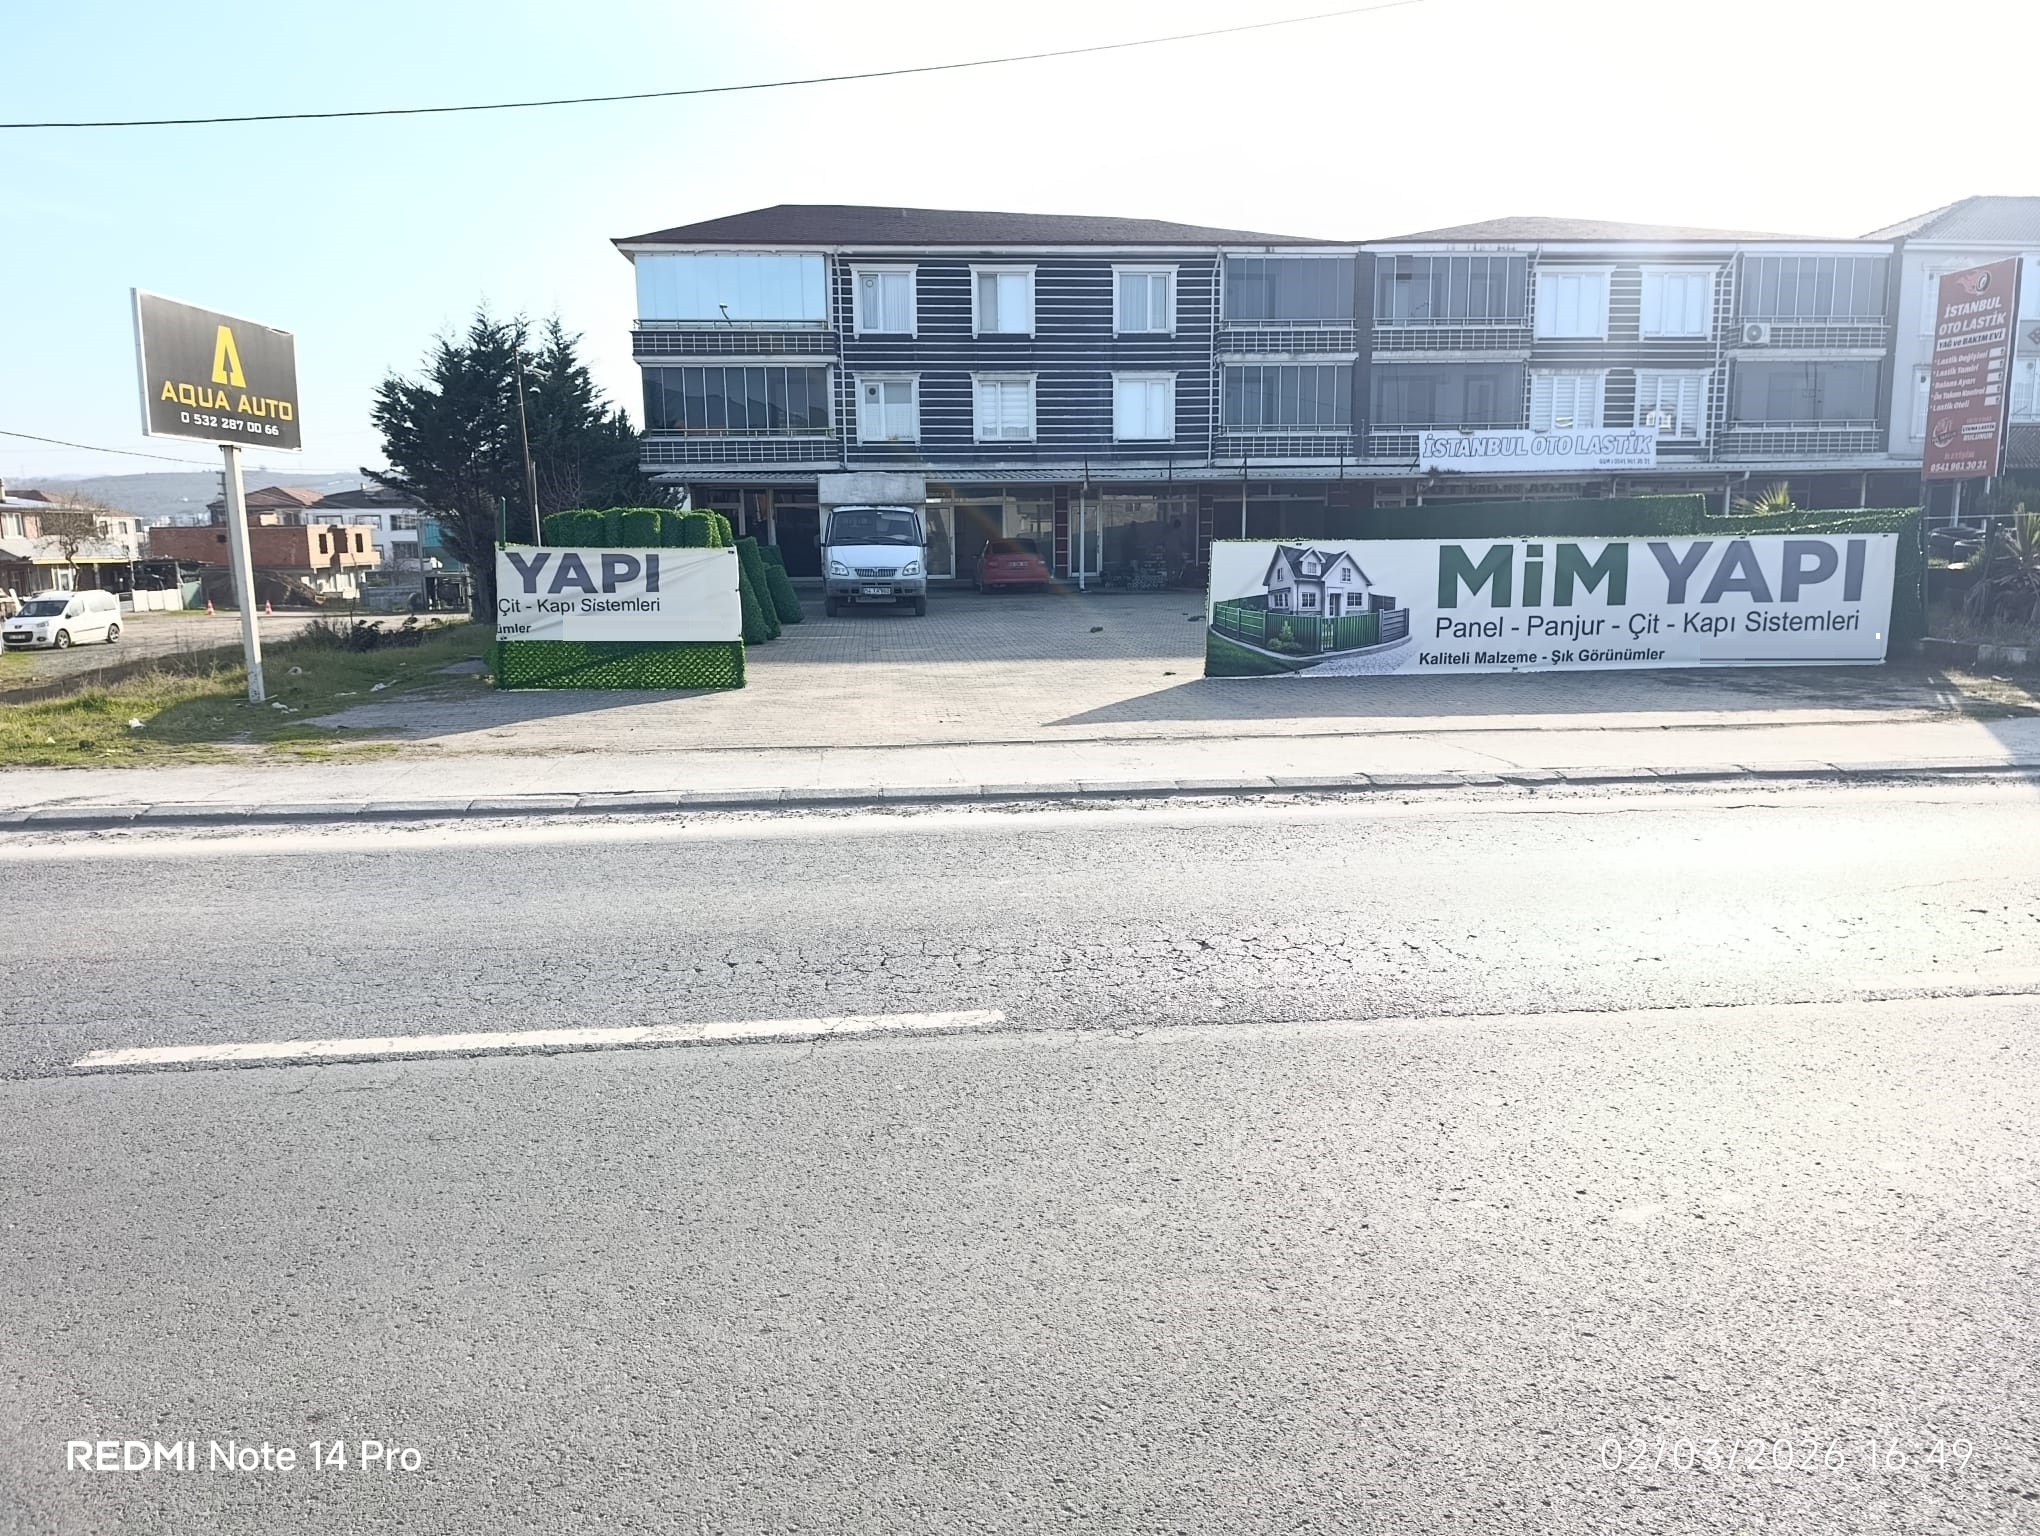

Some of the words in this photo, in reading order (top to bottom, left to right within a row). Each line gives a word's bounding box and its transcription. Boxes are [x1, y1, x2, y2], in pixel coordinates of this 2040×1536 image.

[1944, 296, 2002, 318] İSTANBUL
[1939, 321, 1960, 336] OTO
[1962, 311, 2007, 332] LASTİK
[161, 381, 230, 410] AQUA
[238, 394, 294, 421] AUTO
[180, 412, 189, 423] 0
[193, 414, 217, 427] 532
[221, 417, 243, 431] 287
[247, 421, 262, 433] 00
[265, 424, 279, 436] 66
[1423, 434, 1528, 458] İSTANBUL
[1531, 435, 1573, 456] OTO
[1575, 430, 1654, 455] LASTİK
[506, 552, 660, 594] YAPI
[1647, 539, 1866, 604] YAPI
[498, 597, 521, 616] Çit
[538, 599, 574, 616] Kapı
[581, 597, 660, 612] Sistemleri
[1435, 616, 1504, 638] Panel
[1528, 614, 1605, 641] Panjur
[1629, 612, 1659, 640] Çit
[1684, 612, 1735, 637] Kapı
[1745, 610, 1859, 633] Sistemleri
[1419, 651, 1470, 665] Kaliteli
[1474, 651, 1537, 665] Malzeme
[1551, 649, 1574, 665] Şık
[1578, 648, 1664, 663] Görünümler
